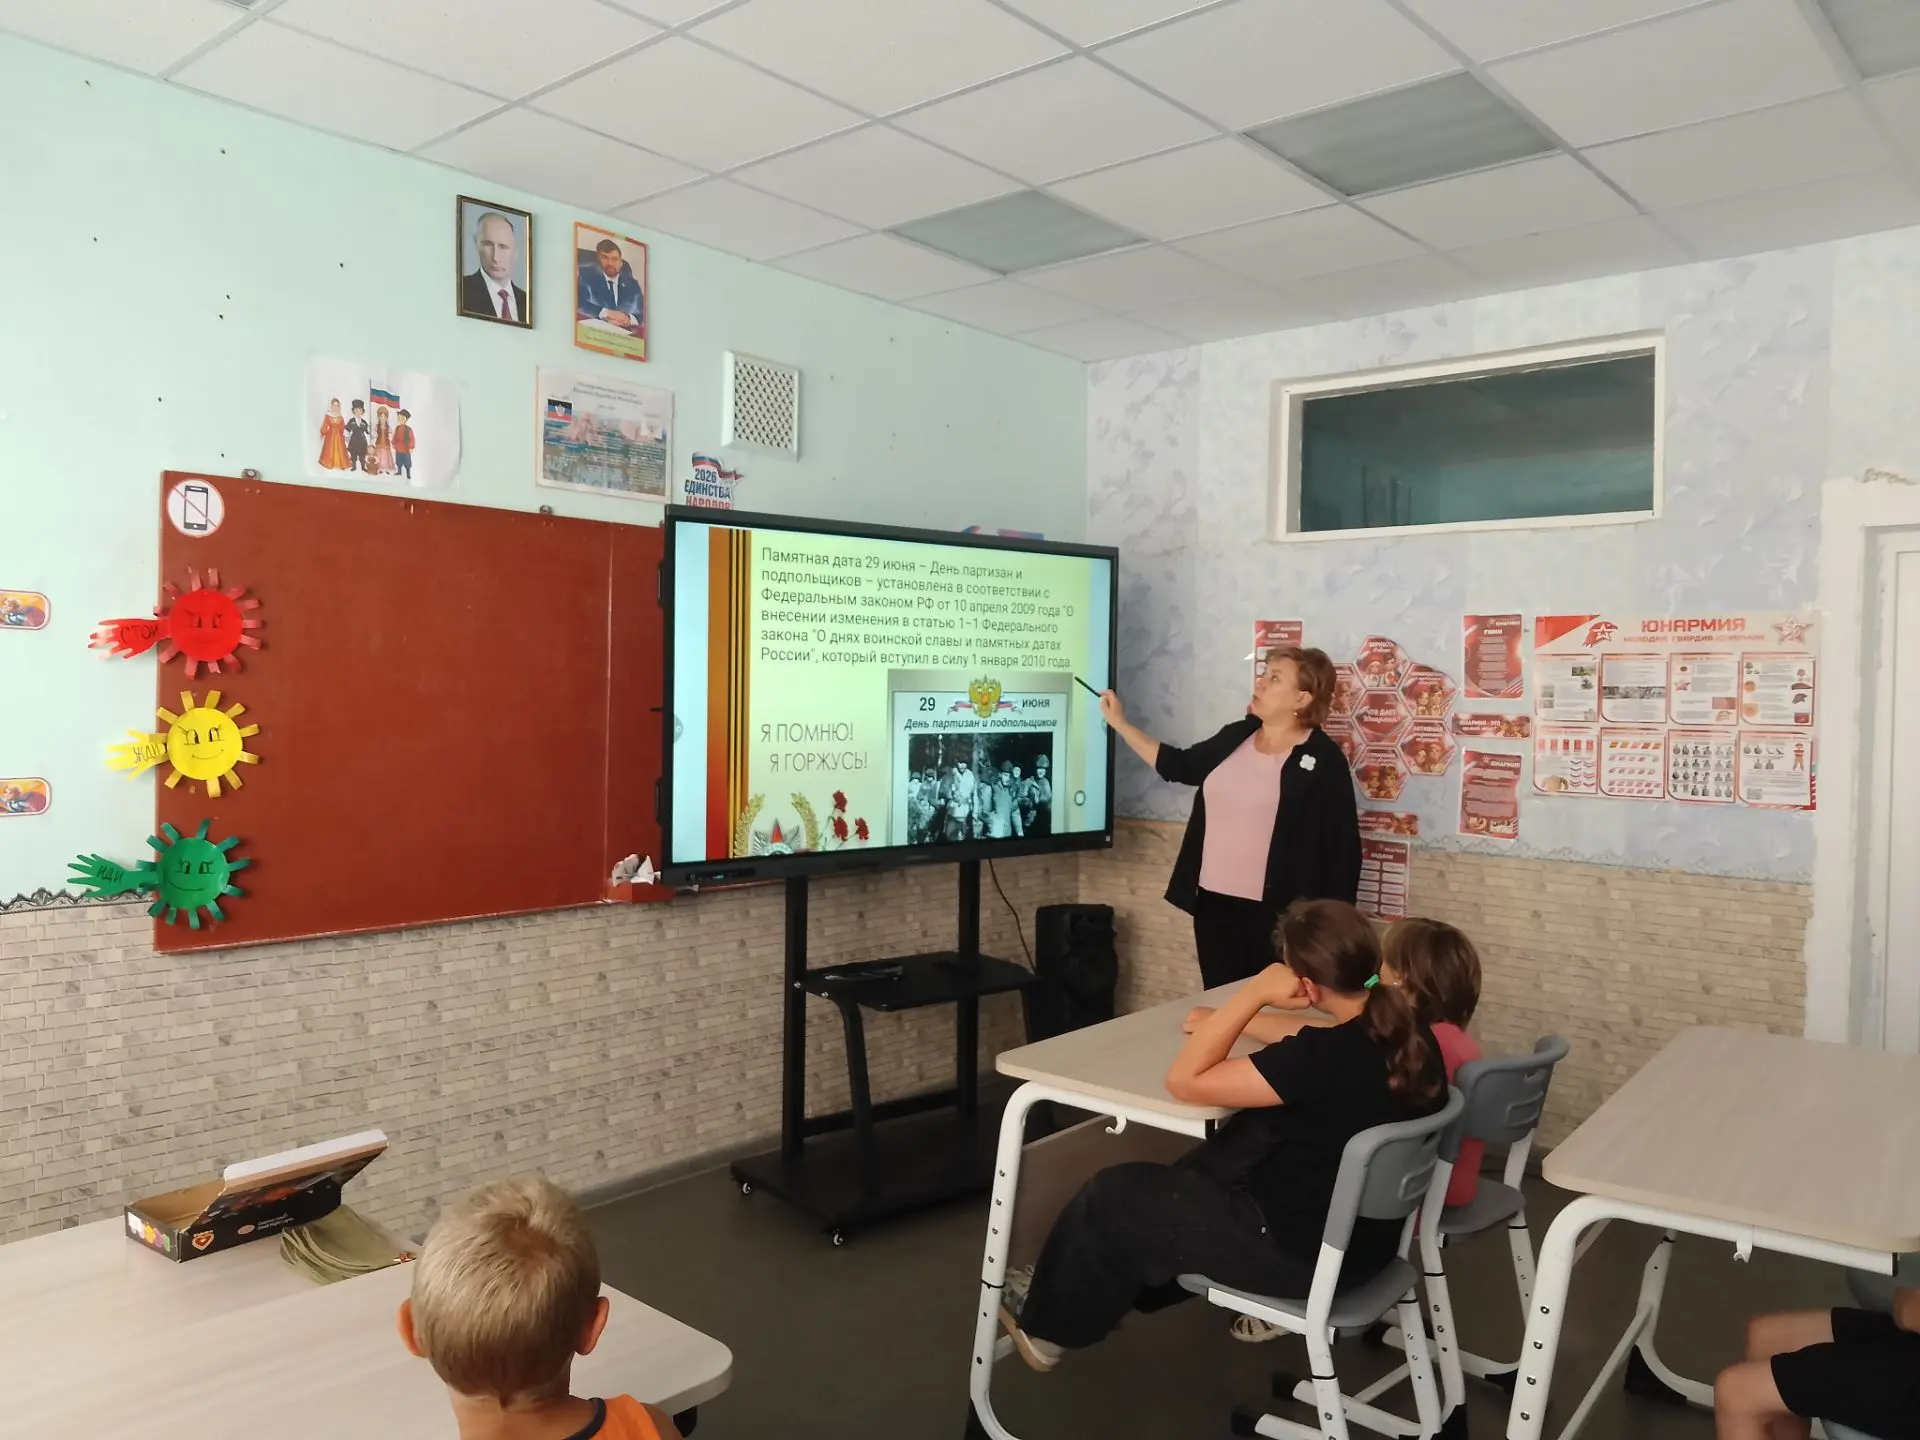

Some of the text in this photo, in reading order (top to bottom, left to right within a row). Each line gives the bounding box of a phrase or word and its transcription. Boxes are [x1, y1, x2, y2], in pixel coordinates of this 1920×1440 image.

[695, 468, 717, 483] 2026
[684, 479, 731, 499] ЕДИНСТВА
[761, 547, 829, 566] Памятная
[832, 555, 862, 568] дата
[865, 555, 880, 568] 29
[883, 560, 915, 571] июня
[930, 560, 959, 576] День
[962, 566, 1013, 579] партизан
[1016, 570, 1023, 579] и
[761, 570, 861, 587] подпольщиков
[877, 577, 953, 593] установлена
[956, 584, 963, 593] в
[966, 584, 1041, 598] соответствии
[1043, 589, 1050, 598] с
[761, 587, 857, 606] Федеральным
[860, 595, 913, 608] законом
[917, 596, 934, 611] РФ
[937, 601, 950, 610] от
[954, 599, 967, 612] 10
[969, 602, 1008, 615] апреля
[1010, 602, 1035, 614] 2009
[1037, 606, 1060, 617] года
[761, 609, 826, 623] внесении
[830, 613, 899, 627] изменения
[902, 617, 909, 627] в
[913, 618, 955, 629] статью
[981, 617, 1058, 633] Федерального
[1641, 617, 1746, 633] ЮНАРМИЯ
[761, 630, 808, 642] закона
[829, 632, 860, 645] днях
[863, 632, 923, 646] воинской
[925, 636, 962, 647] славы
[965, 638, 972, 647] и
[975, 638, 1030, 649] памятных
[1032, 640, 1062, 651] датах
[822, 650, 877, 666] который
[880, 653, 929, 666] вступил
[932, 655, 939, 664] в
[942, 655, 969, 668] силу
[972, 653, 977, 665] 1
[981, 657, 1018, 668] января
[1021, 655, 1045, 667] 2010
[919, 697, 1050, 711] 29 июня
[761, 722, 854, 743] Я ПОМНЮ!
[904, 718, 1058, 731] День партизан и подпольщиков
[133, 744, 161, 764] ЖДИ
[770, 751, 868, 772] Я ГОРЖУСЬ!
[97, 863, 124, 884] ИДИ
